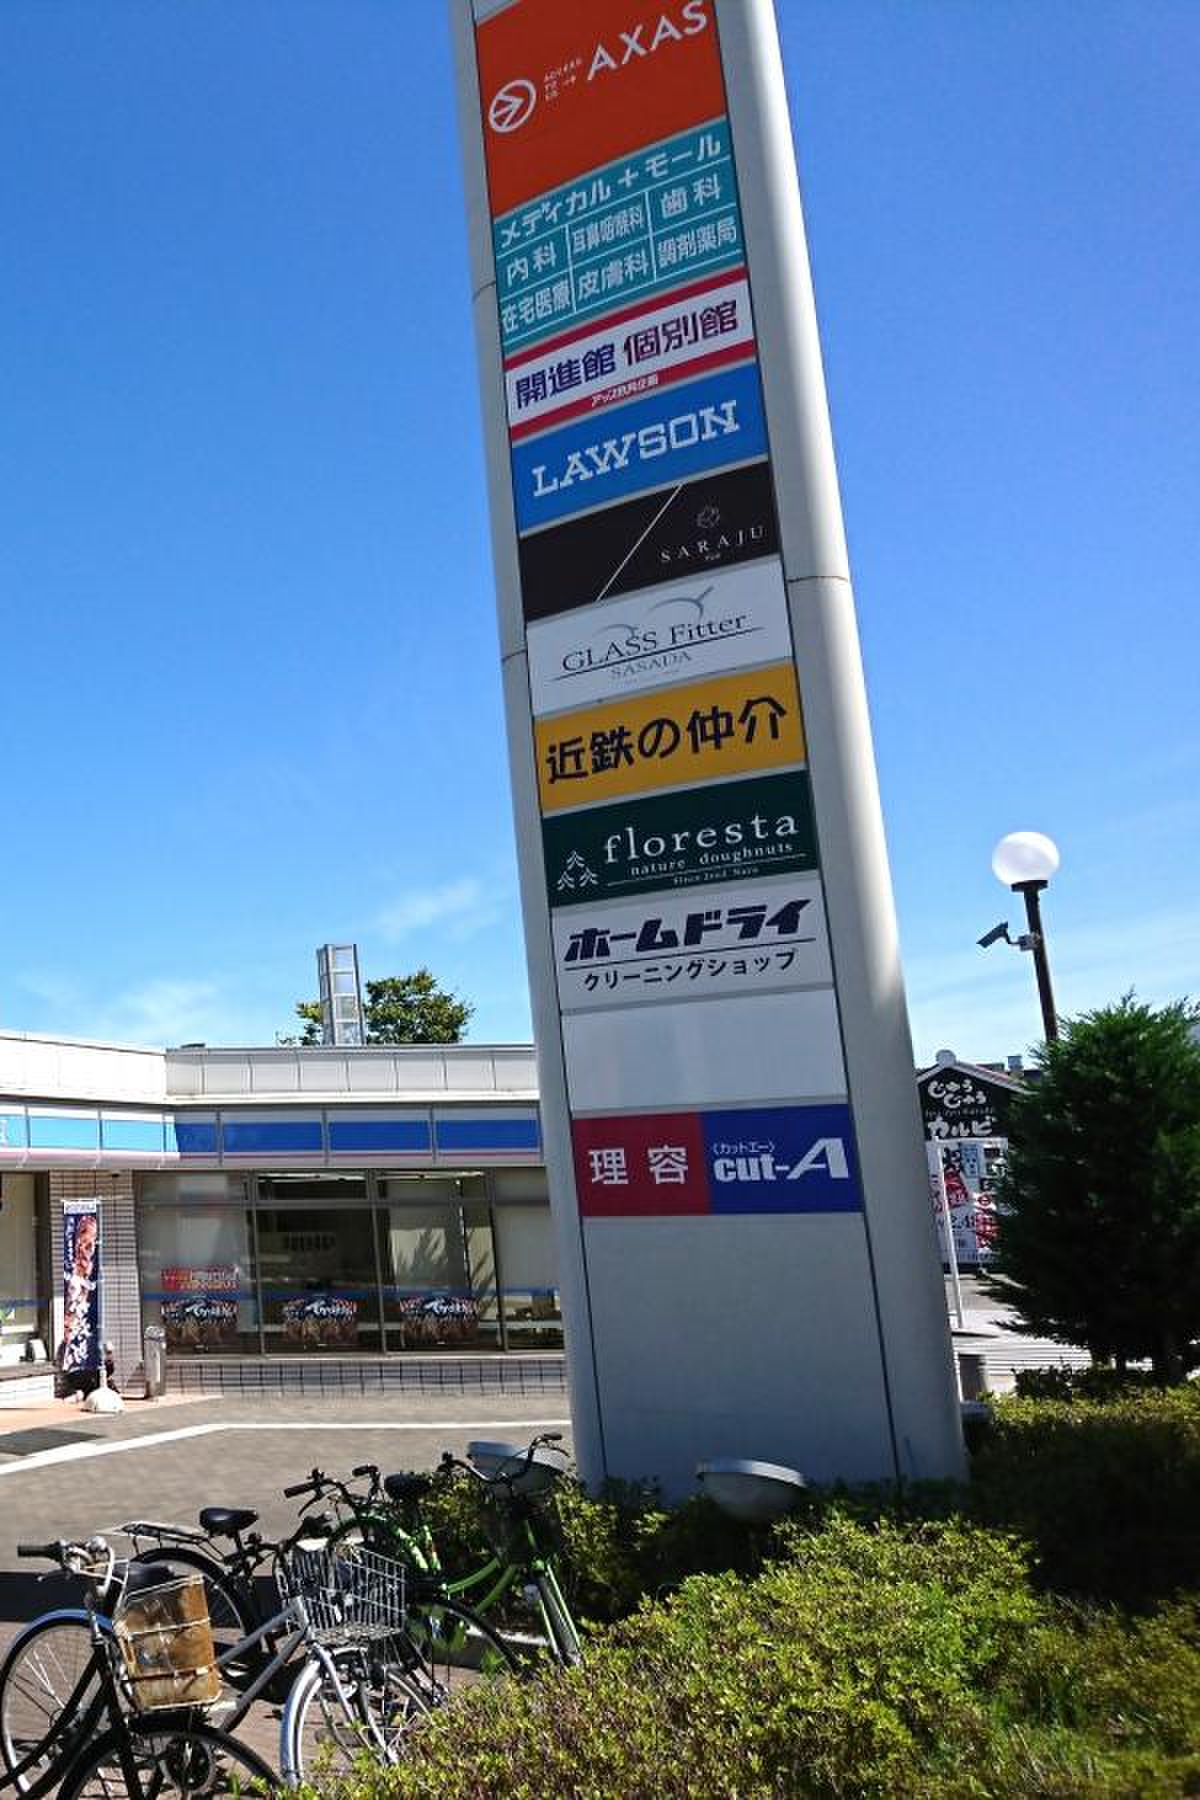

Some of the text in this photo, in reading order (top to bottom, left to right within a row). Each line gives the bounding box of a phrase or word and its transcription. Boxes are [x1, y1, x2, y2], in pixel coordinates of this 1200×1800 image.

[586, 0, 707, 80] AXAS
[660, 174, 721, 218] 歯科
[506, 242, 557, 285] 内科
[578, 250, 649, 300] 皮膚科
[515, 299, 738, 409] 開進館 個別館
[531, 400, 740, 497] LAWSON
[660, 525, 764, 563] SARAJU
[562, 614, 748, 672] GLASS Fitter
[546, 696, 786, 784] 近鉄の仲介
[603, 814, 799, 864] floresta
[630, 843, 793, 876] nature doughnuts
[563, 899, 813, 962] ホームドライ
[584, 951, 797, 991] クリーニングショップ
[927, 1115, 997, 1137] カルビ
[588, 1145, 690, 1185] 理容
[713, 1137, 850, 1182] cut-A
